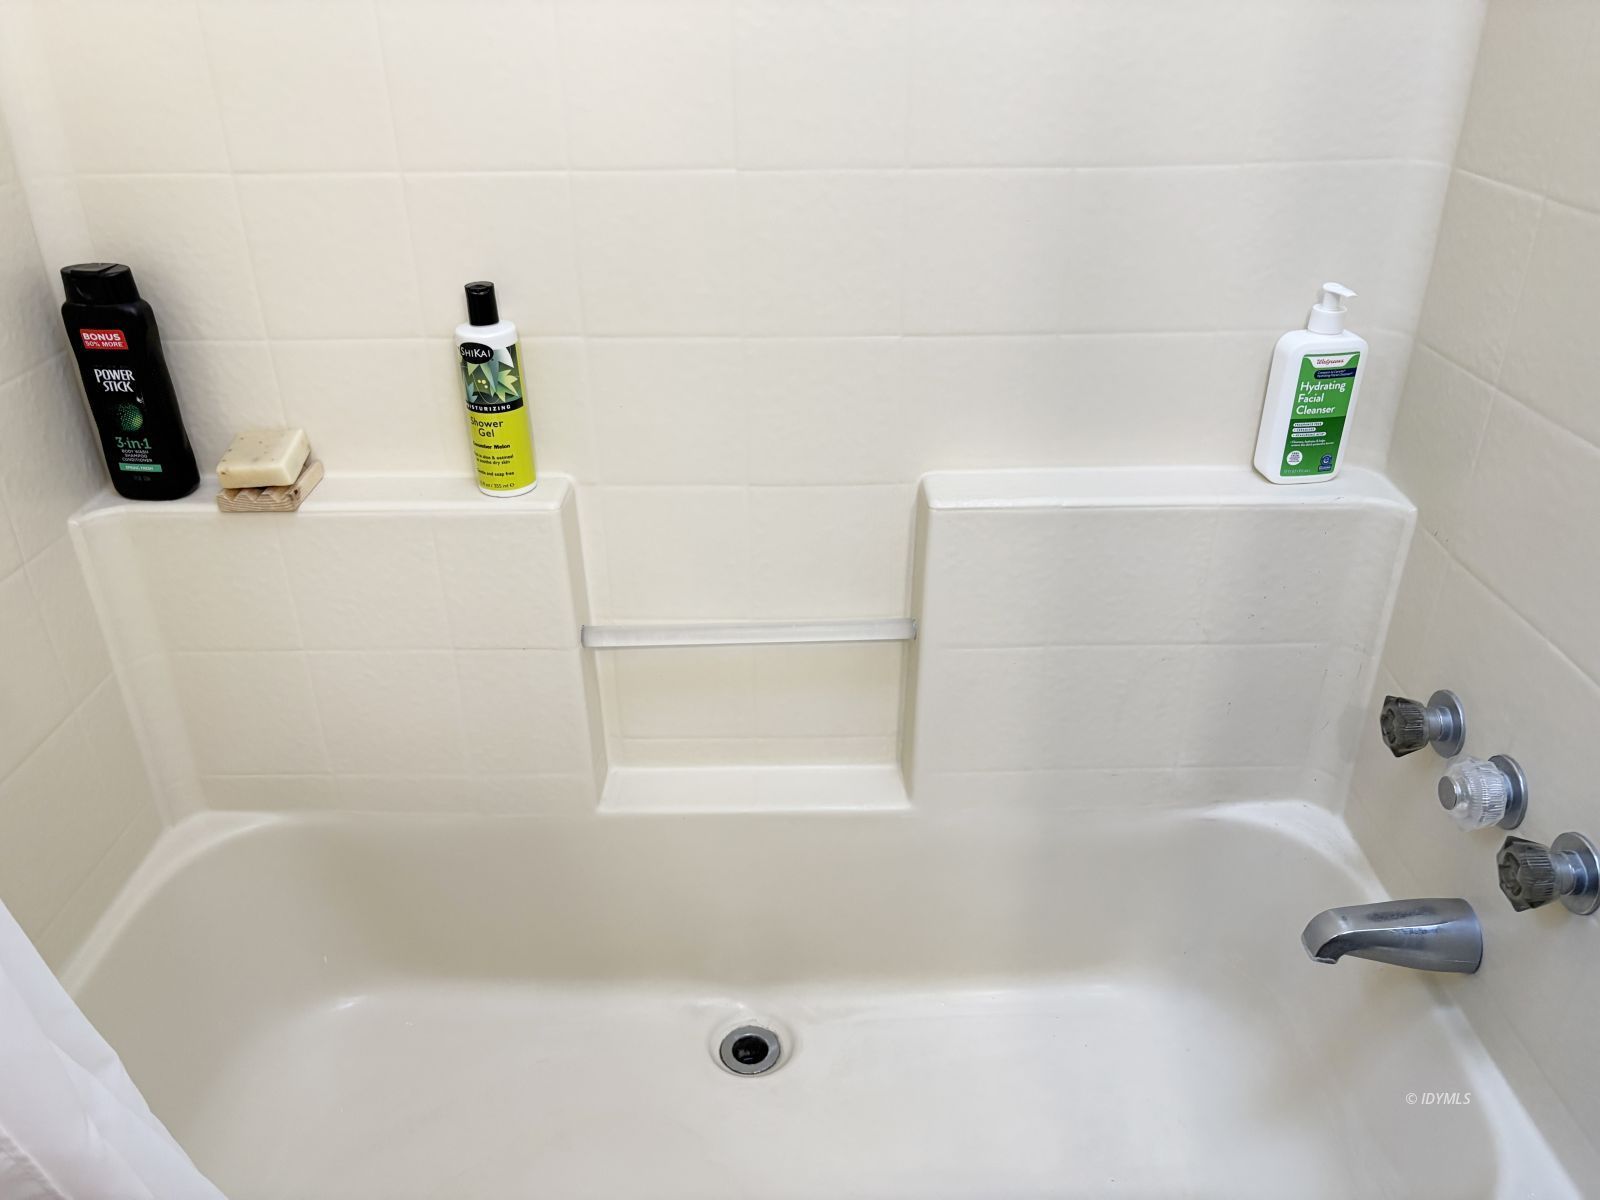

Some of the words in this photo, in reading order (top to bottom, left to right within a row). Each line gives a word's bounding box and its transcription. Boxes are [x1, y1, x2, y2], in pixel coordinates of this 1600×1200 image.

[82, 332, 121, 341] BONUS
[460, 346, 491, 358] SHIKAI
[93, 368, 135, 382] POWER
[102, 381, 134, 392] STICK
[1300, 380, 1346, 394] Hydrating
[1298, 393, 1325, 403] Facial
[467, 404, 511, 412] ISTURIZING
[1296, 405, 1336, 415] Cleanser
[470, 416, 503, 428] Shower
[479, 428, 495, 437] Gel
